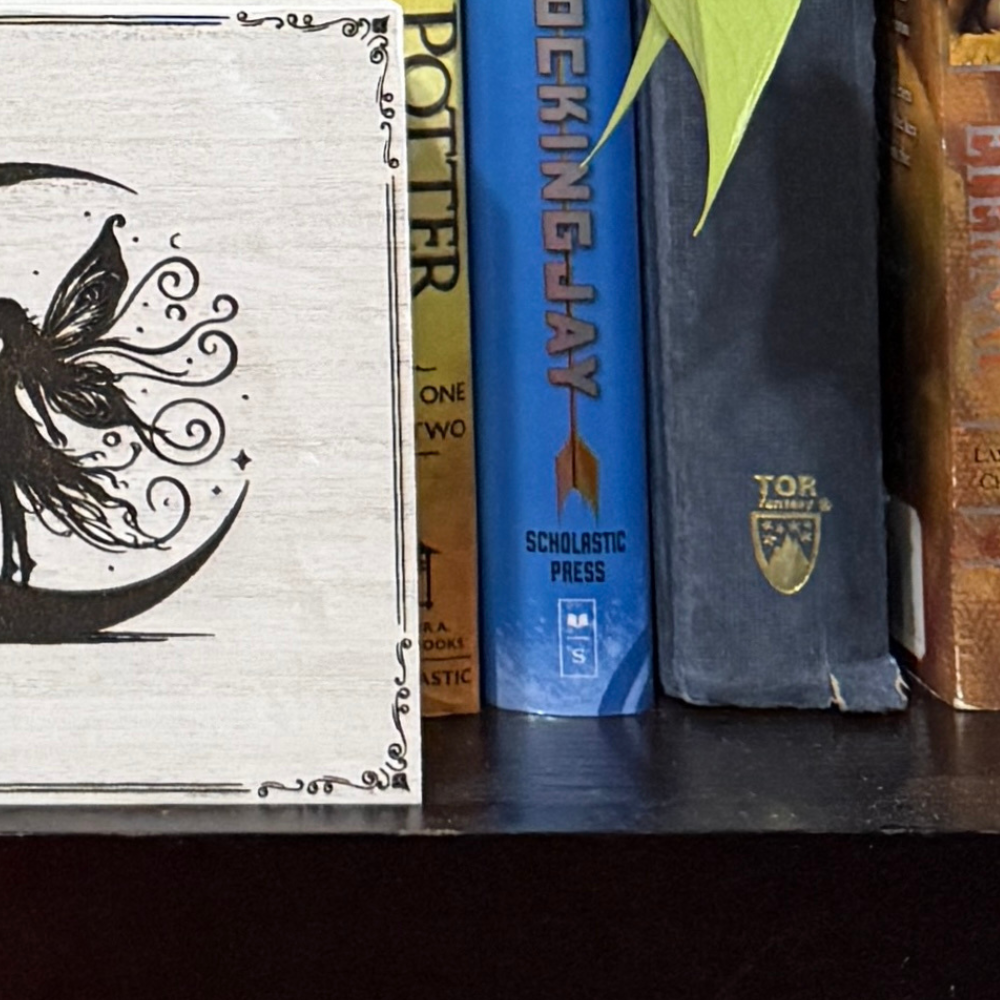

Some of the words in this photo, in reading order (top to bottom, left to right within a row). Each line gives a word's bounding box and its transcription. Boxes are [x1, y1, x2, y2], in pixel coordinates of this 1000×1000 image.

[419, 381, 466, 405] ONE
[753, 474, 818, 498] TOR
[525, 530, 627, 554] SCHOLASTIC
[550, 560, 606, 584] PRESS
